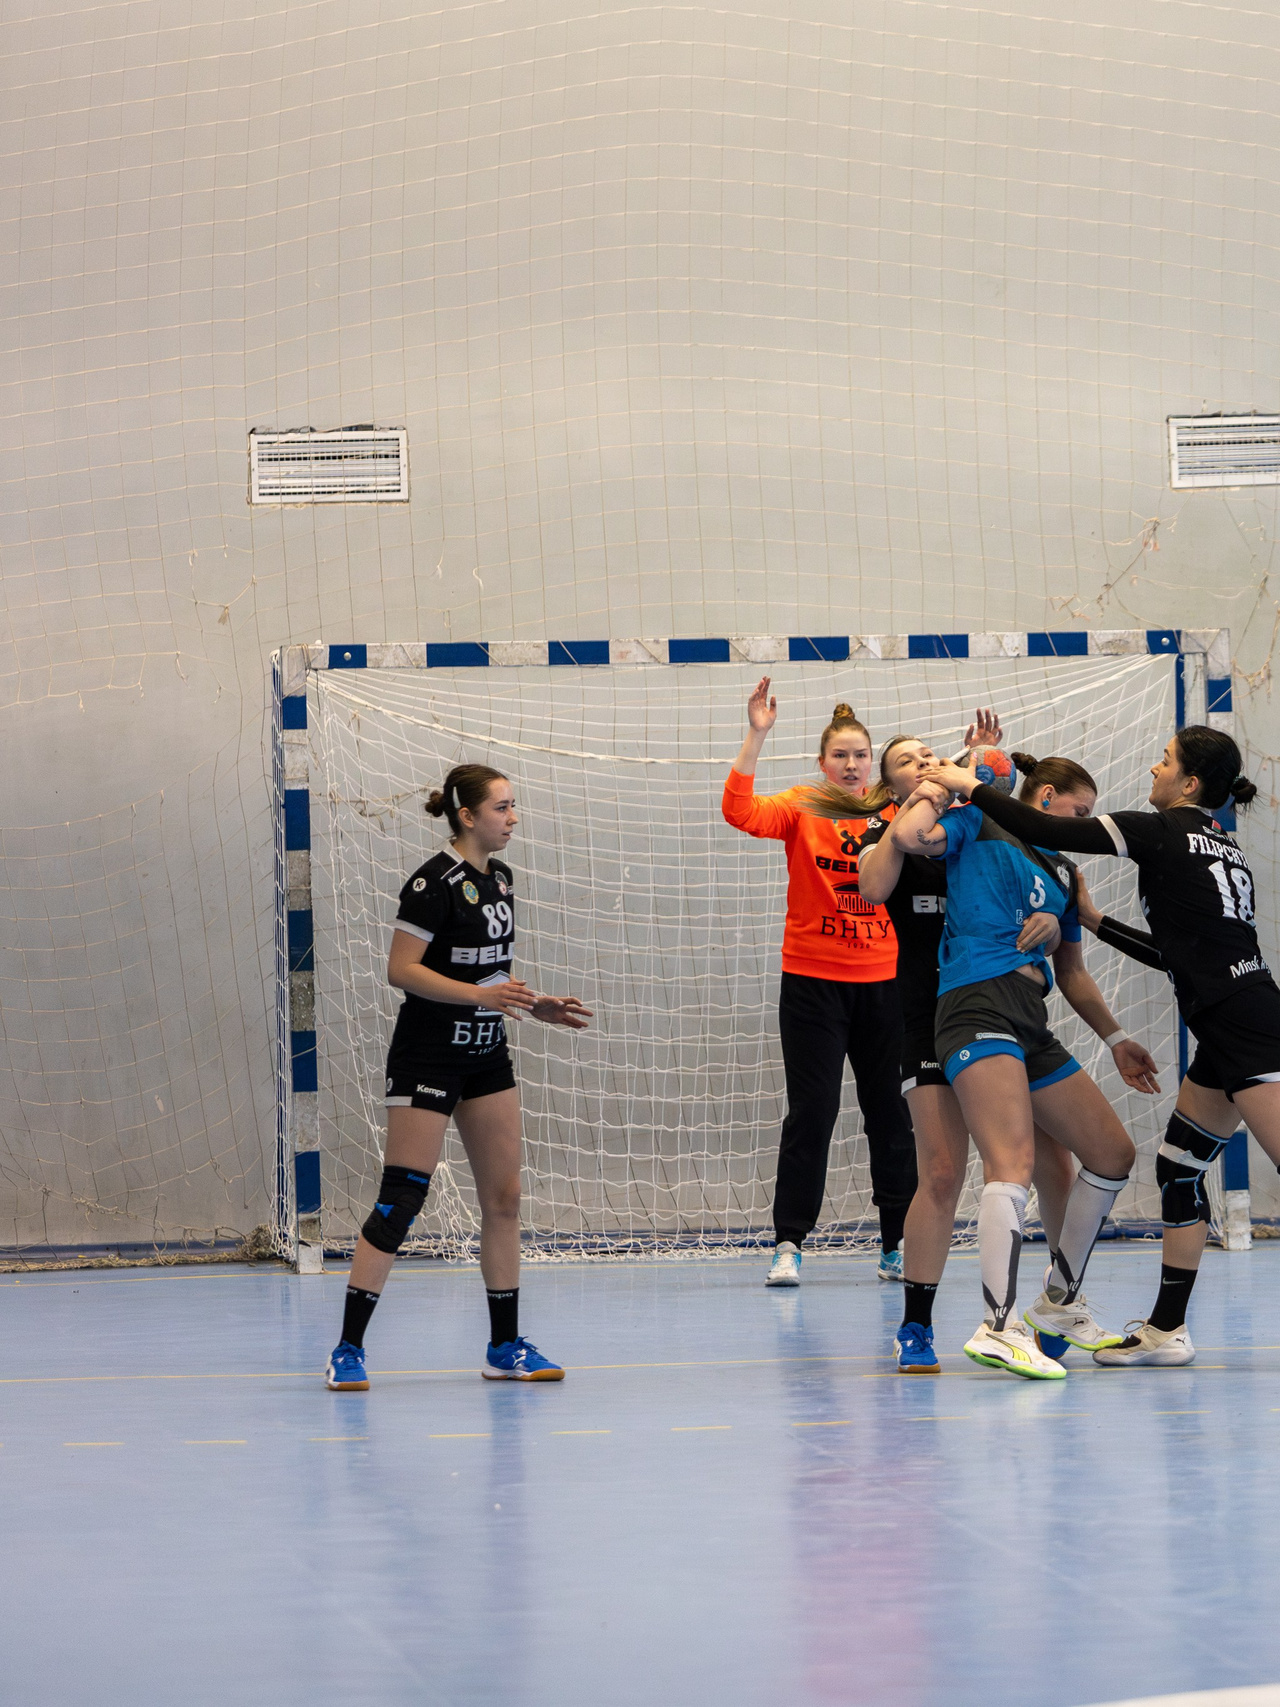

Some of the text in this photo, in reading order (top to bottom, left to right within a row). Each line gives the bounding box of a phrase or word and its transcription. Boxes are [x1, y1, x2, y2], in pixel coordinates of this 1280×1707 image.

[1029, 875, 1046, 909] 5
[1208, 860, 1256, 928] 18
[481, 901, 513, 939] 89
[820, 915, 891, 939] БНТУ
[1230, 955, 1260, 978] Minsk
[417, 1084, 447, 1098] Kempa
